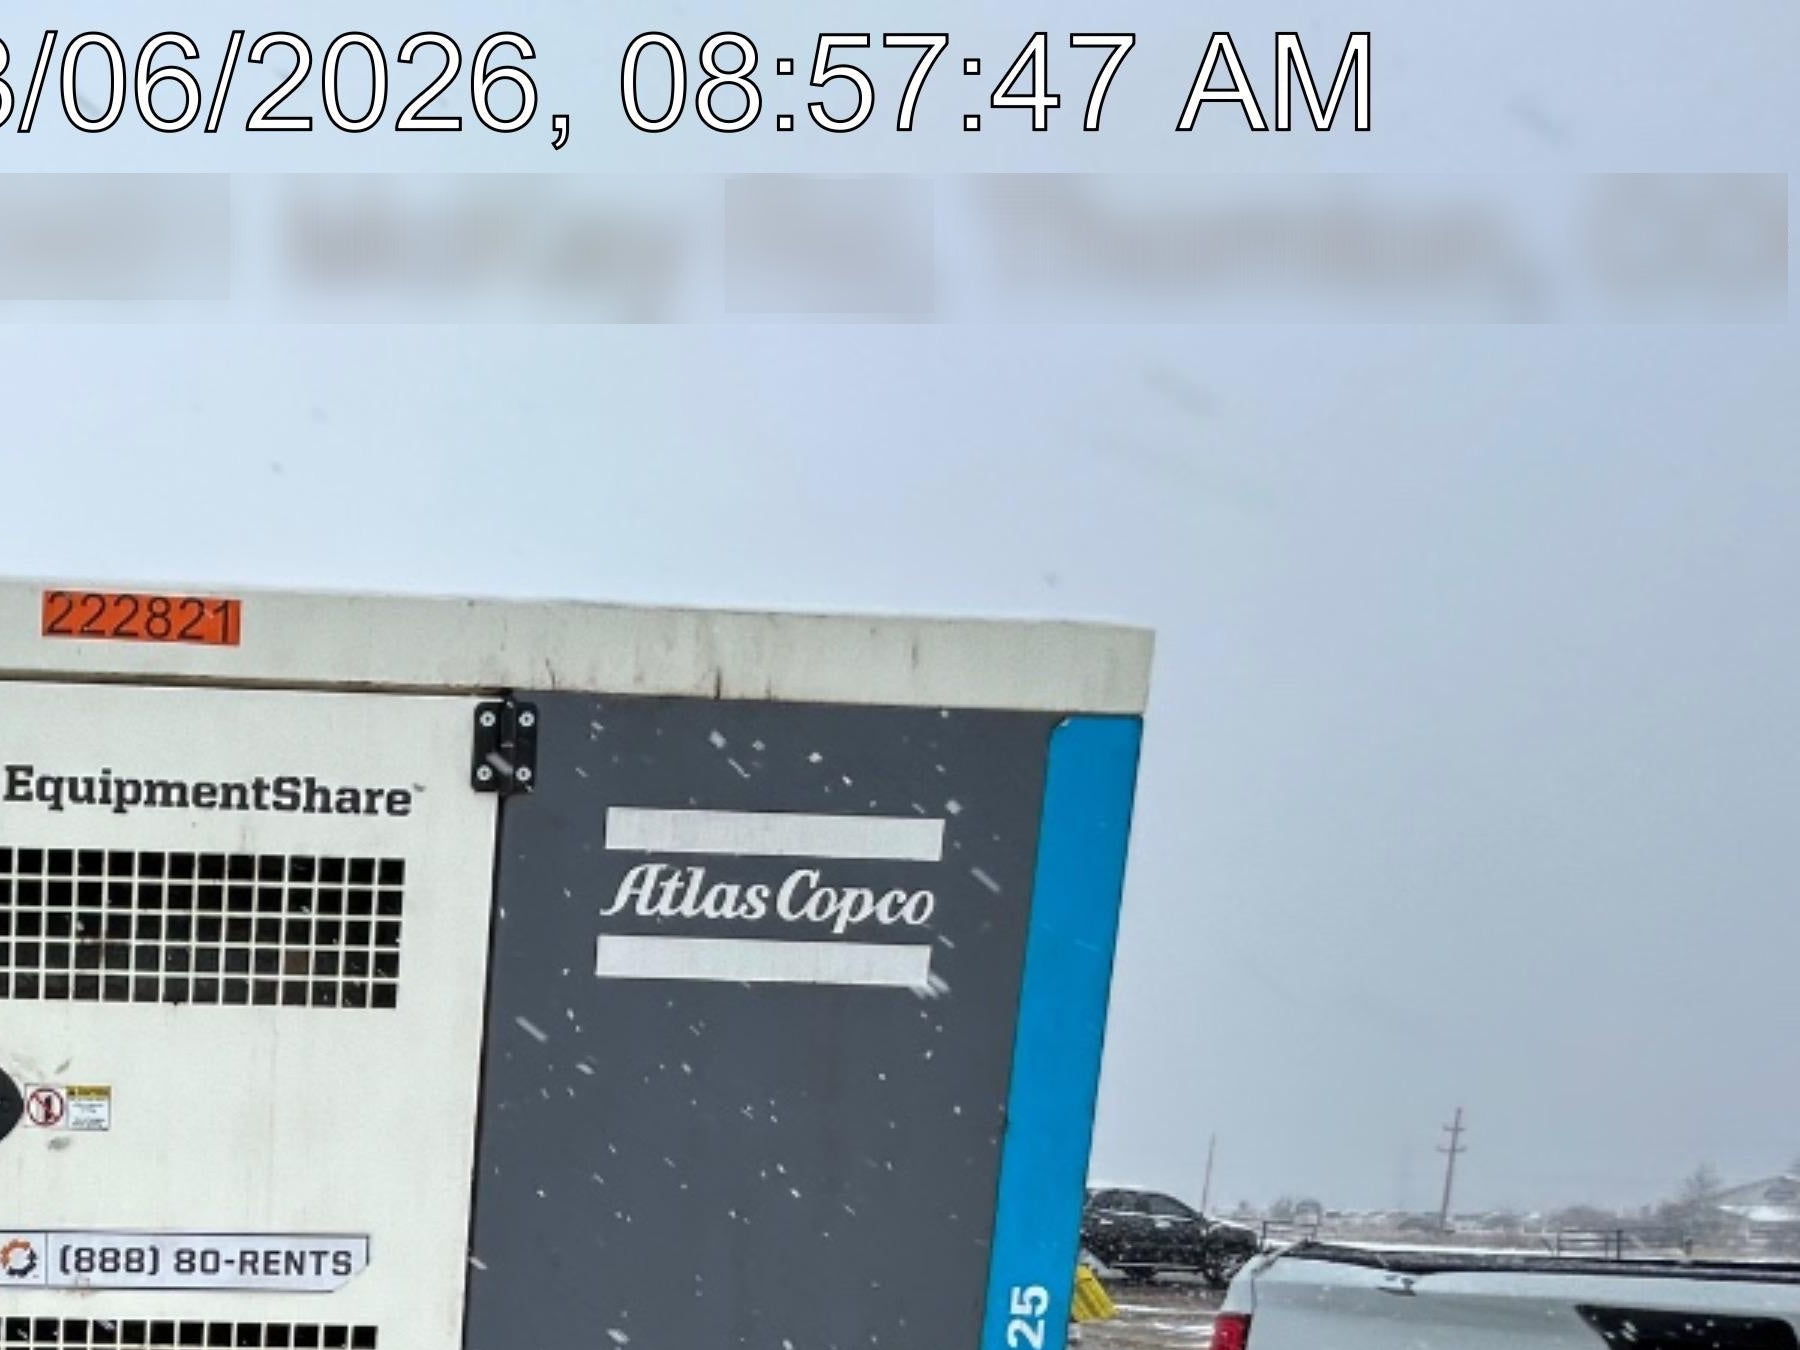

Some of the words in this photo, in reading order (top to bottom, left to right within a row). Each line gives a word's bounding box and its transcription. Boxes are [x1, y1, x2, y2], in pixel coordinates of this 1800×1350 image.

[47, 591, 230, 643] 222821
[3, 764, 412, 816] EquipmentShare
[601, 862, 769, 920] Atlas
[775, 868, 935, 933] Copco
[59, 1244, 160, 1276] (888)
[173, 1248, 352, 1277] 80-RENTS
